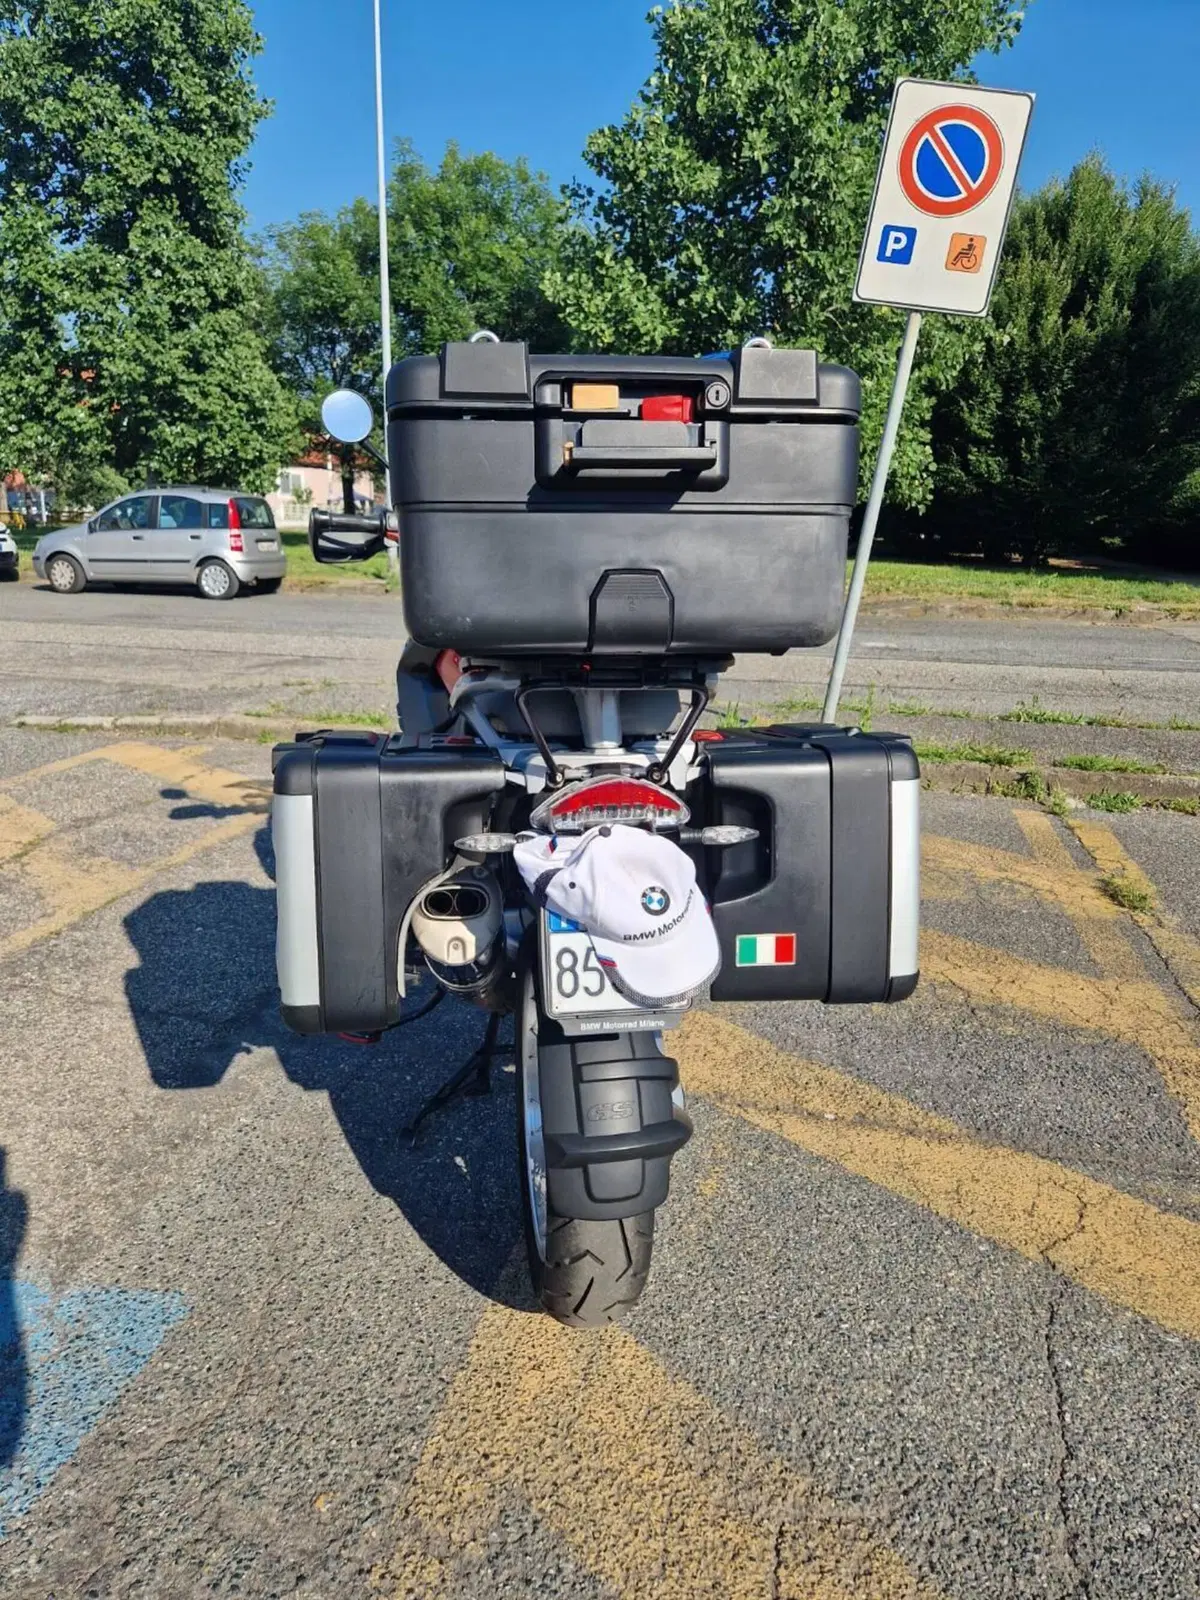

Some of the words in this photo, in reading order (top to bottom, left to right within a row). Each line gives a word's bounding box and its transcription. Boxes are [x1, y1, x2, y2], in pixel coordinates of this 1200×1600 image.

[885, 231, 907, 257] P
[623, 930, 656, 941] BMW
[580, 1022, 601, 1031] BMW
[602, 1021, 638, 1029] Motorrad
[639, 1020, 665, 1028] Milano
[587, 1101, 634, 1122] GS
